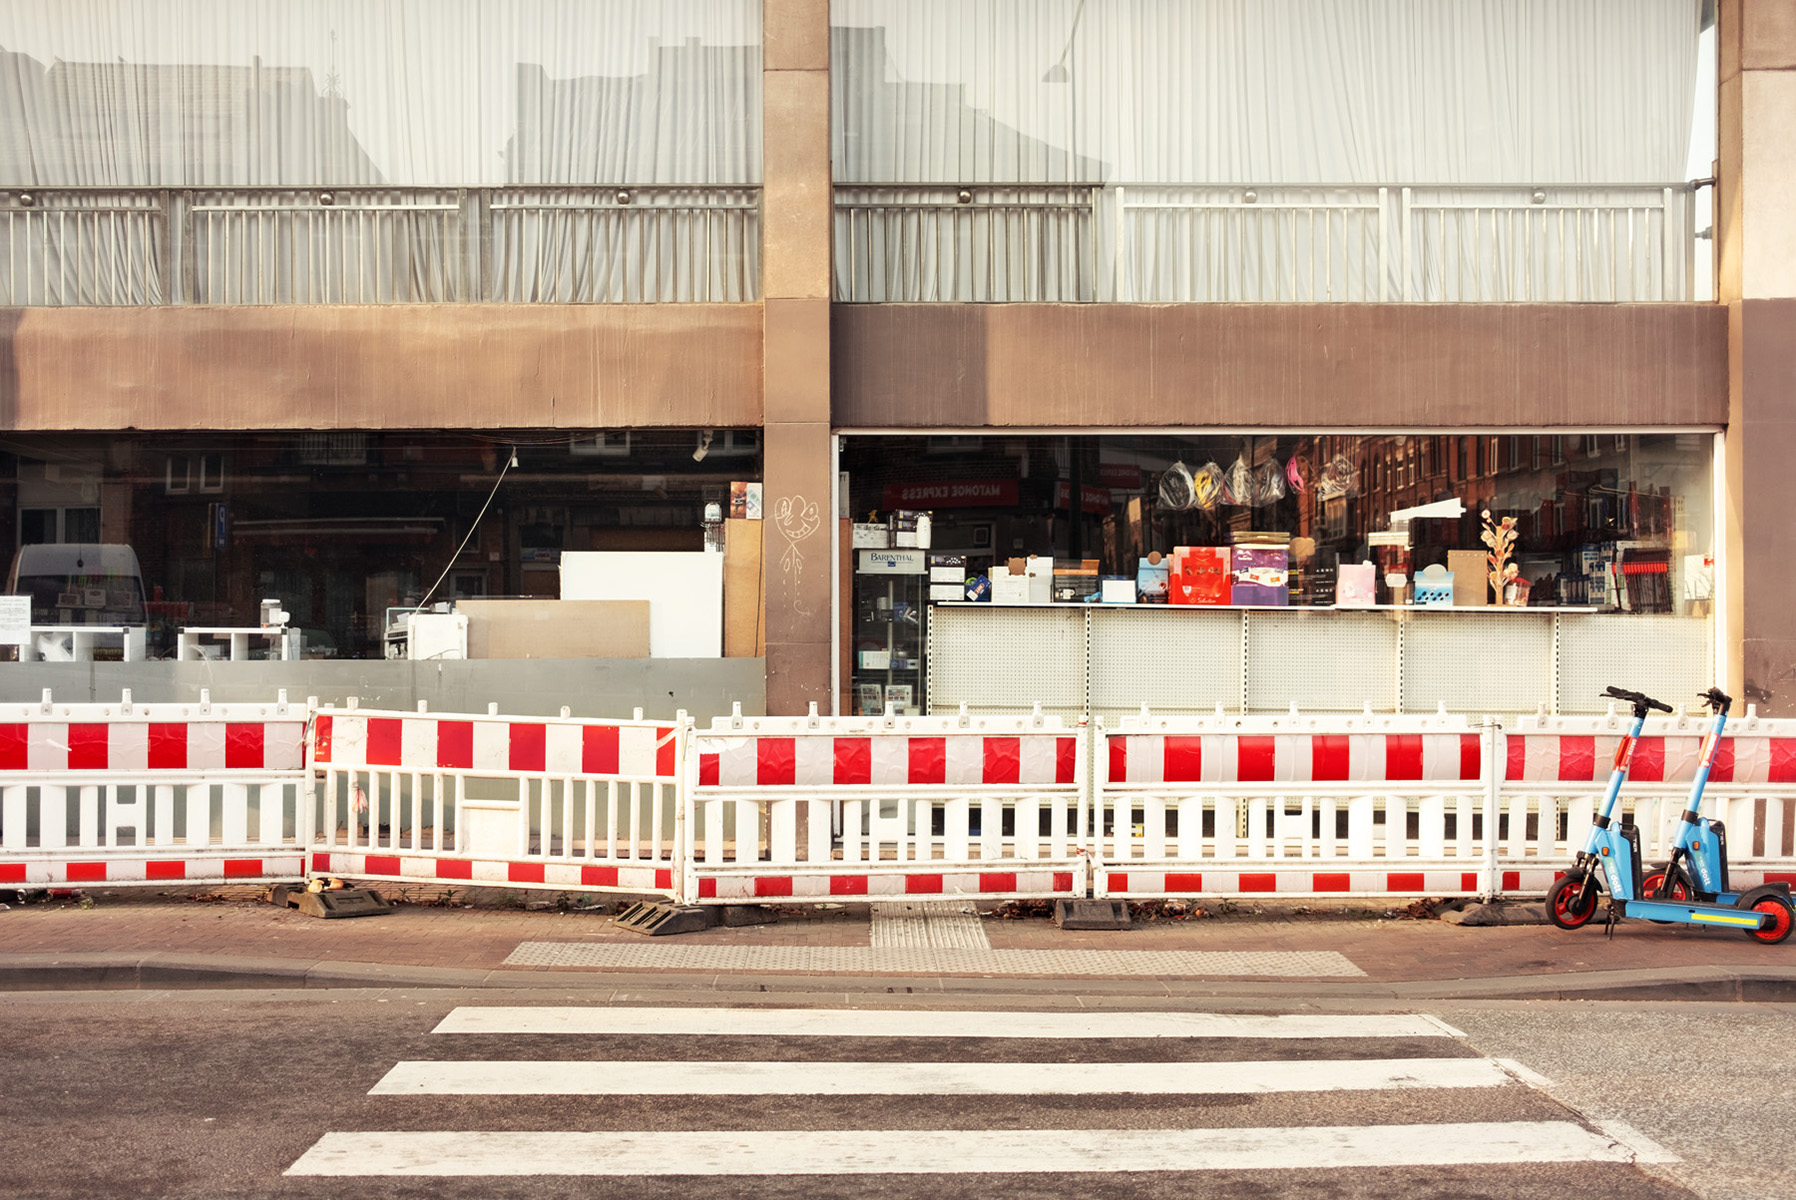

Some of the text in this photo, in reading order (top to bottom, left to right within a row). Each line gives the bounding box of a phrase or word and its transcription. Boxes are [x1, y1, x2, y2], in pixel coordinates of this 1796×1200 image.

[870, 552, 914, 561] BARENTHAL
[1610, 875, 1623, 894] dott
[1701, 868, 1710, 886] dott
